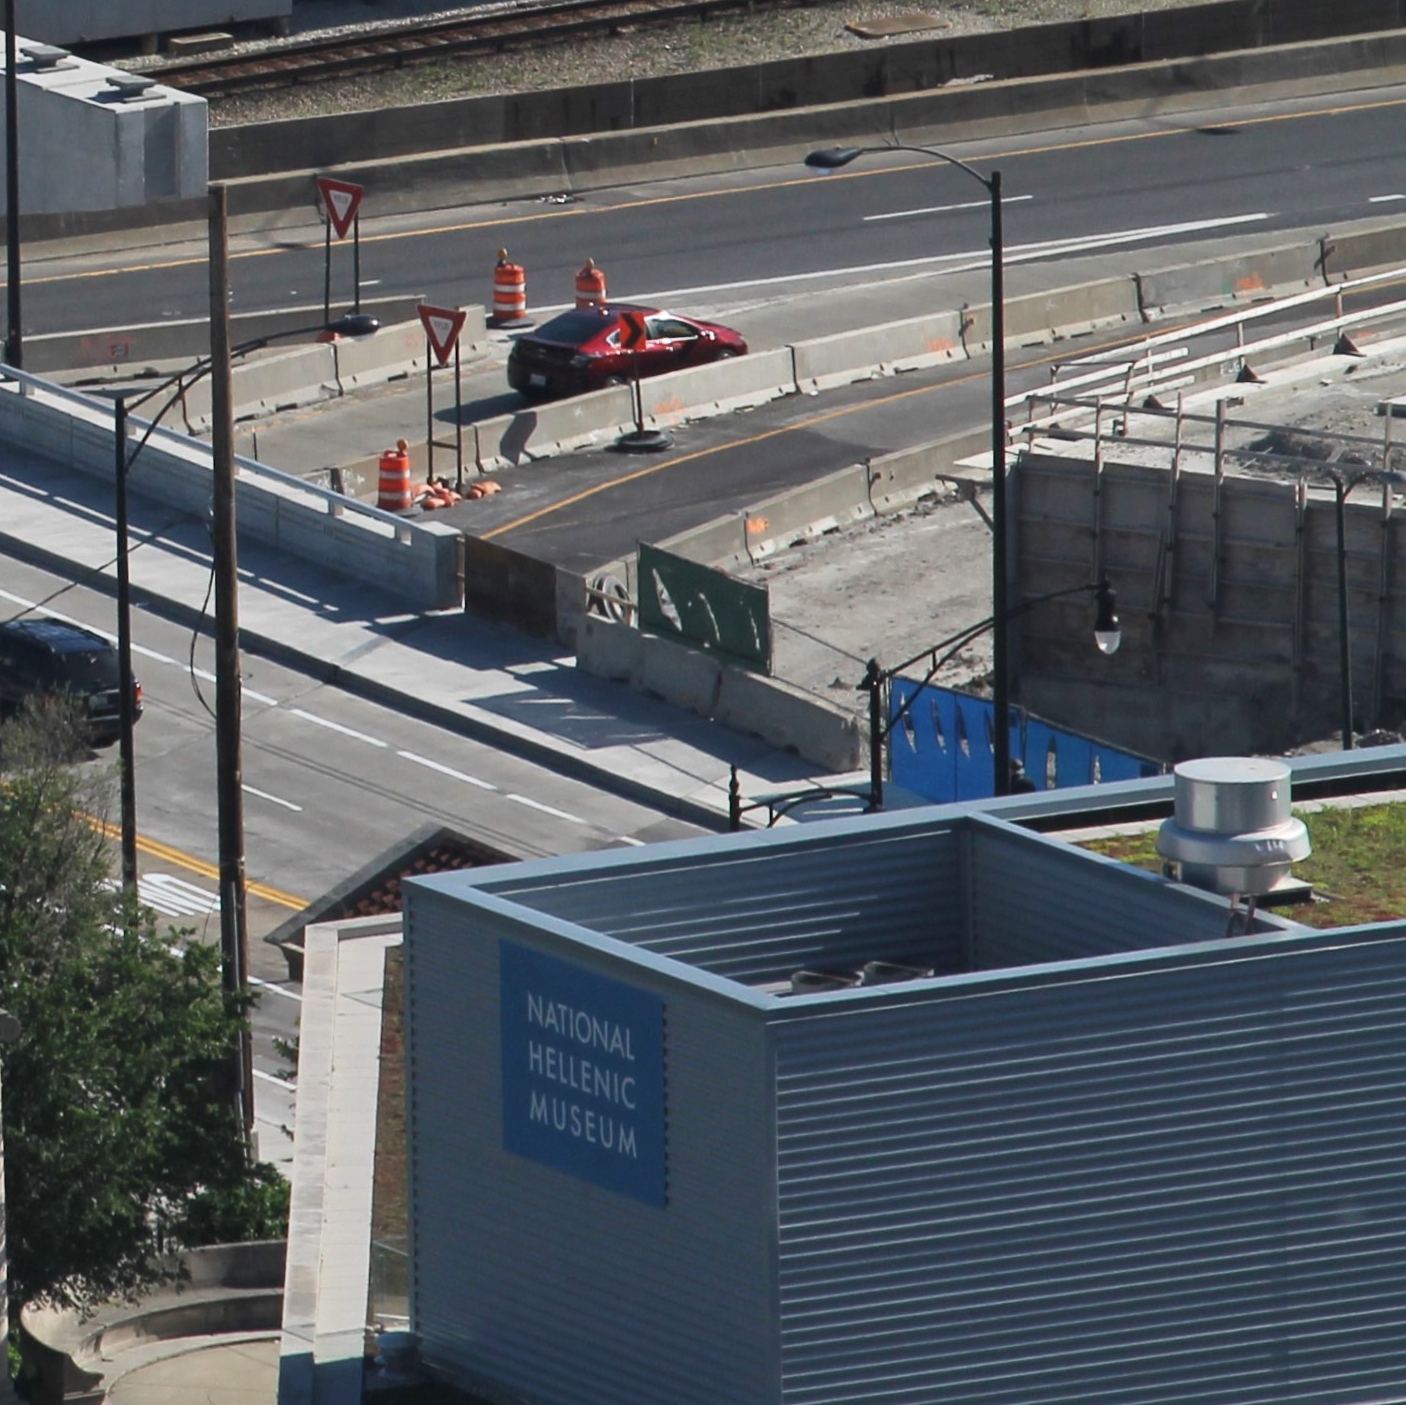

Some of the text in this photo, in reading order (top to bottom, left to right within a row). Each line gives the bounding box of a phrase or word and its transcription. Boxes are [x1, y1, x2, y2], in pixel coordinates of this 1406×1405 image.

[527, 990, 636, 1061] NATIONAL
[528, 1040, 637, 1111] HELLENIC
[529, 1089, 638, 1159] MUSEUM
